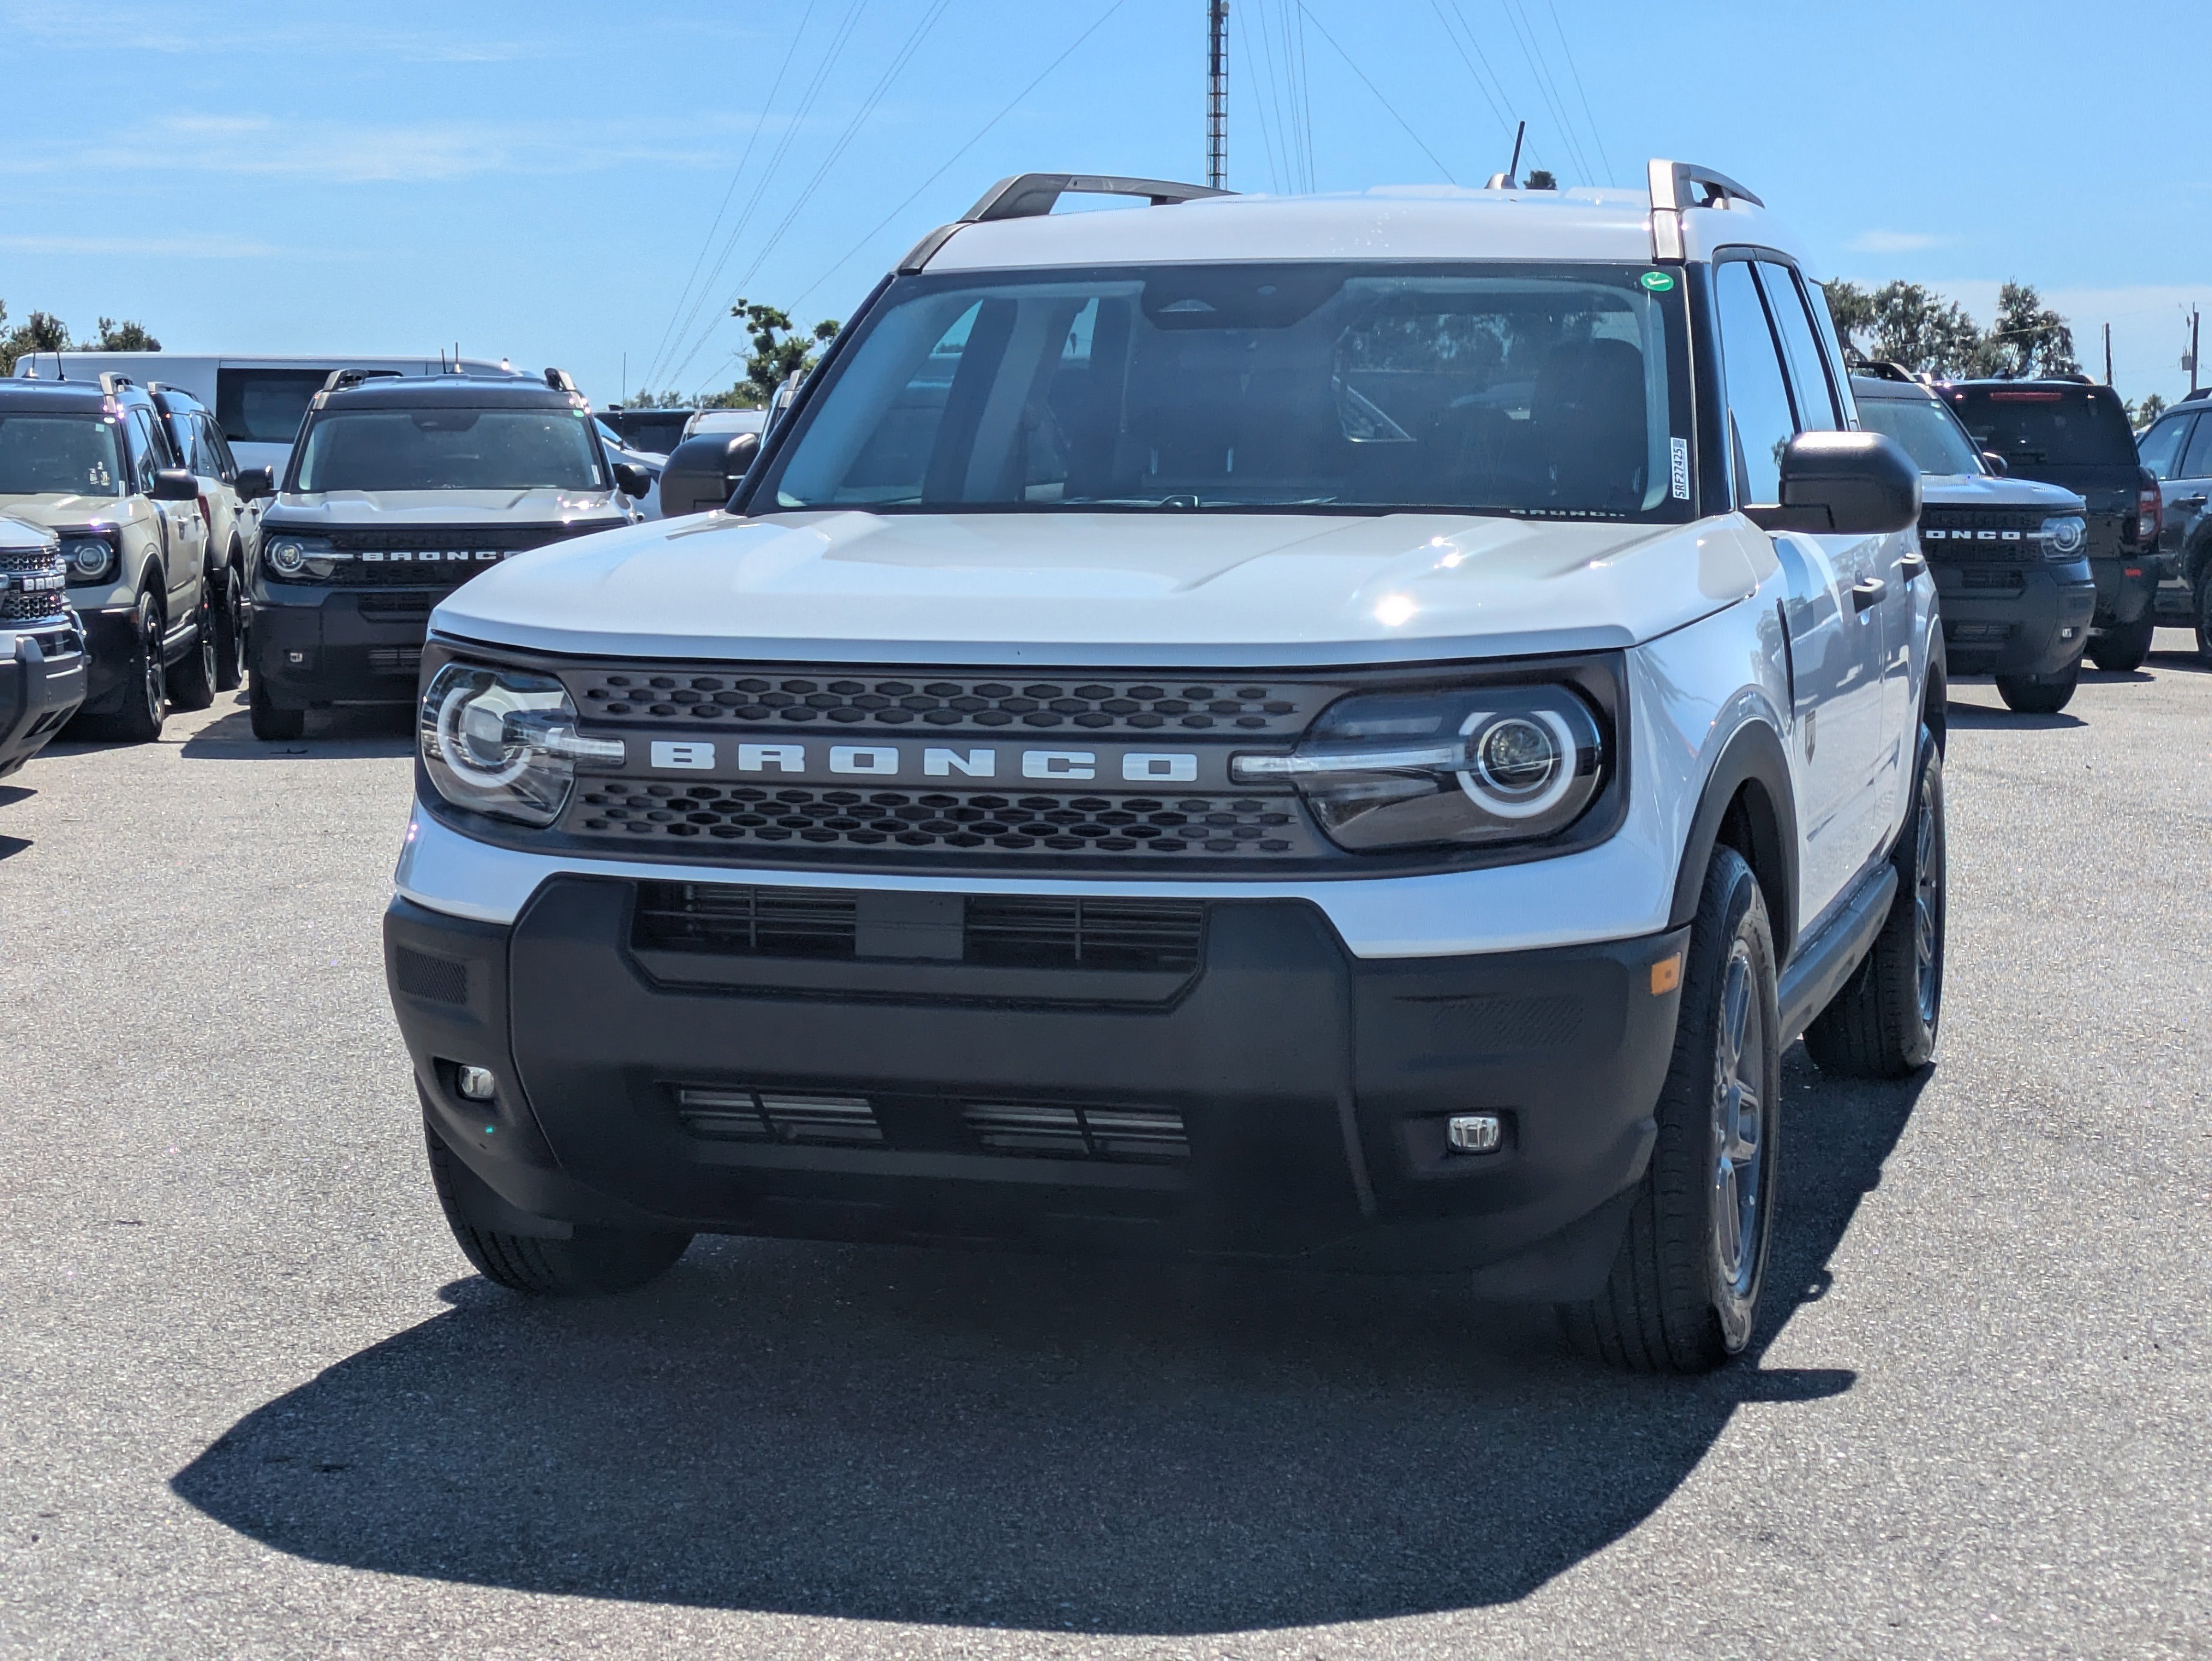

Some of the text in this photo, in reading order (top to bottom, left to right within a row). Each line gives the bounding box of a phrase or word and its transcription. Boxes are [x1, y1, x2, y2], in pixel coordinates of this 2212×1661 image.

[1674, 448, 1685, 498] SRF27425
[1926, 530, 2020, 540] ONCO
[651, 741, 1197, 781] BRONCO
